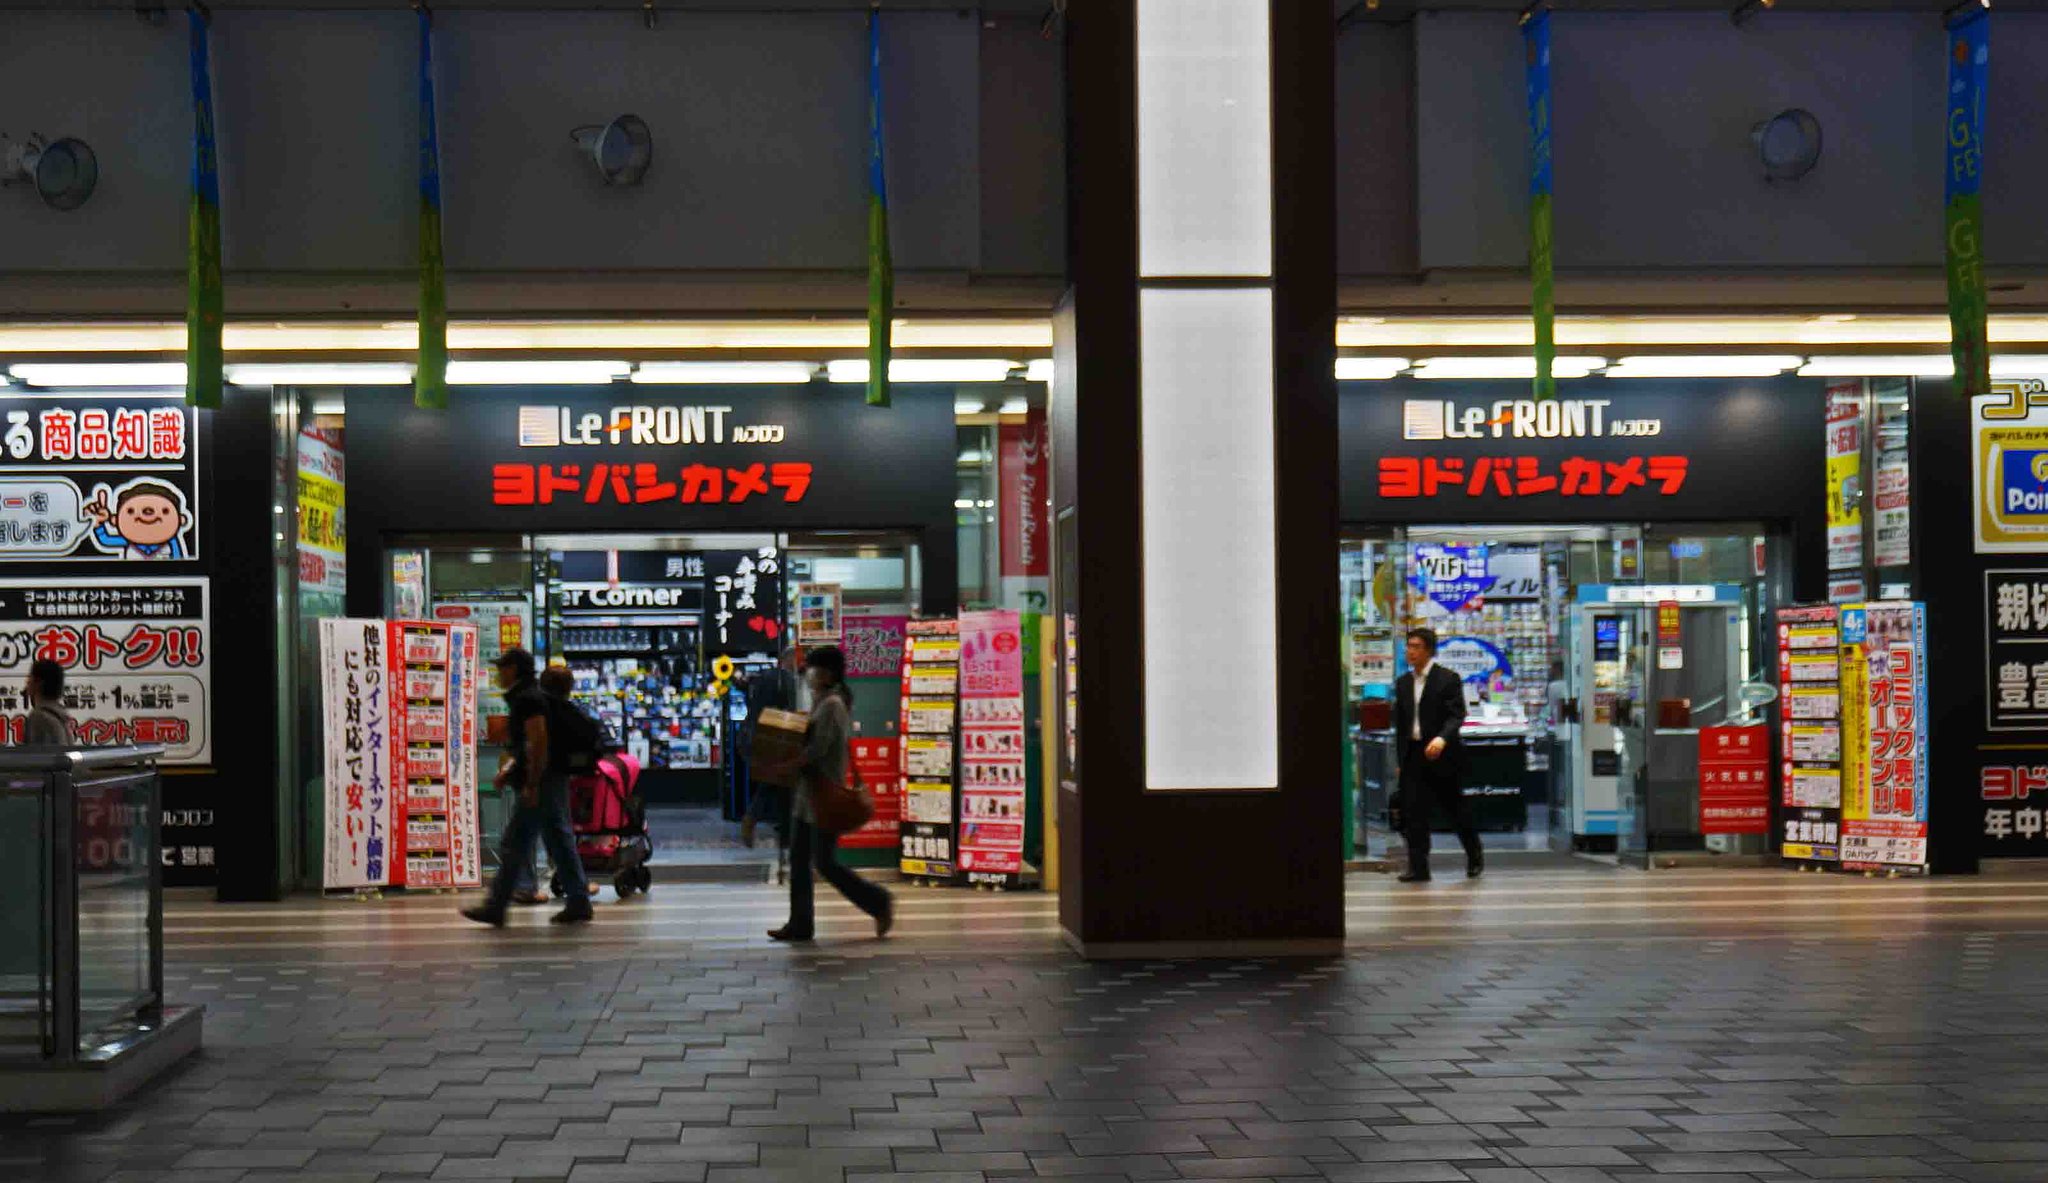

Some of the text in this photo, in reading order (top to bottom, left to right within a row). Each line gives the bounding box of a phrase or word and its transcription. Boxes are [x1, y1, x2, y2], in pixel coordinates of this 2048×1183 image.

[0, 407, 186, 459] る商品知識
[561, 406, 603, 445] Le
[607, 406, 733, 445] FRONT
[1445, 400, 1485, 438] Le
[1490, 400, 1611, 438] FRONT
[492, 462, 813, 504] ヨドバシカメラ
[1378, 456, 1689, 497] ヨドバシカメラ
[0, 491, 49, 515] ーを
[665, 557, 704, 578] 男性
[588, 587, 683, 607] Corner
[714, 575, 733, 645] コーナー
[363, 624, 384, 881] 他社のインターネット価格
[1890, 648, 1914, 817] コミック売場
[1984, 808, 2048, 839] 年中
